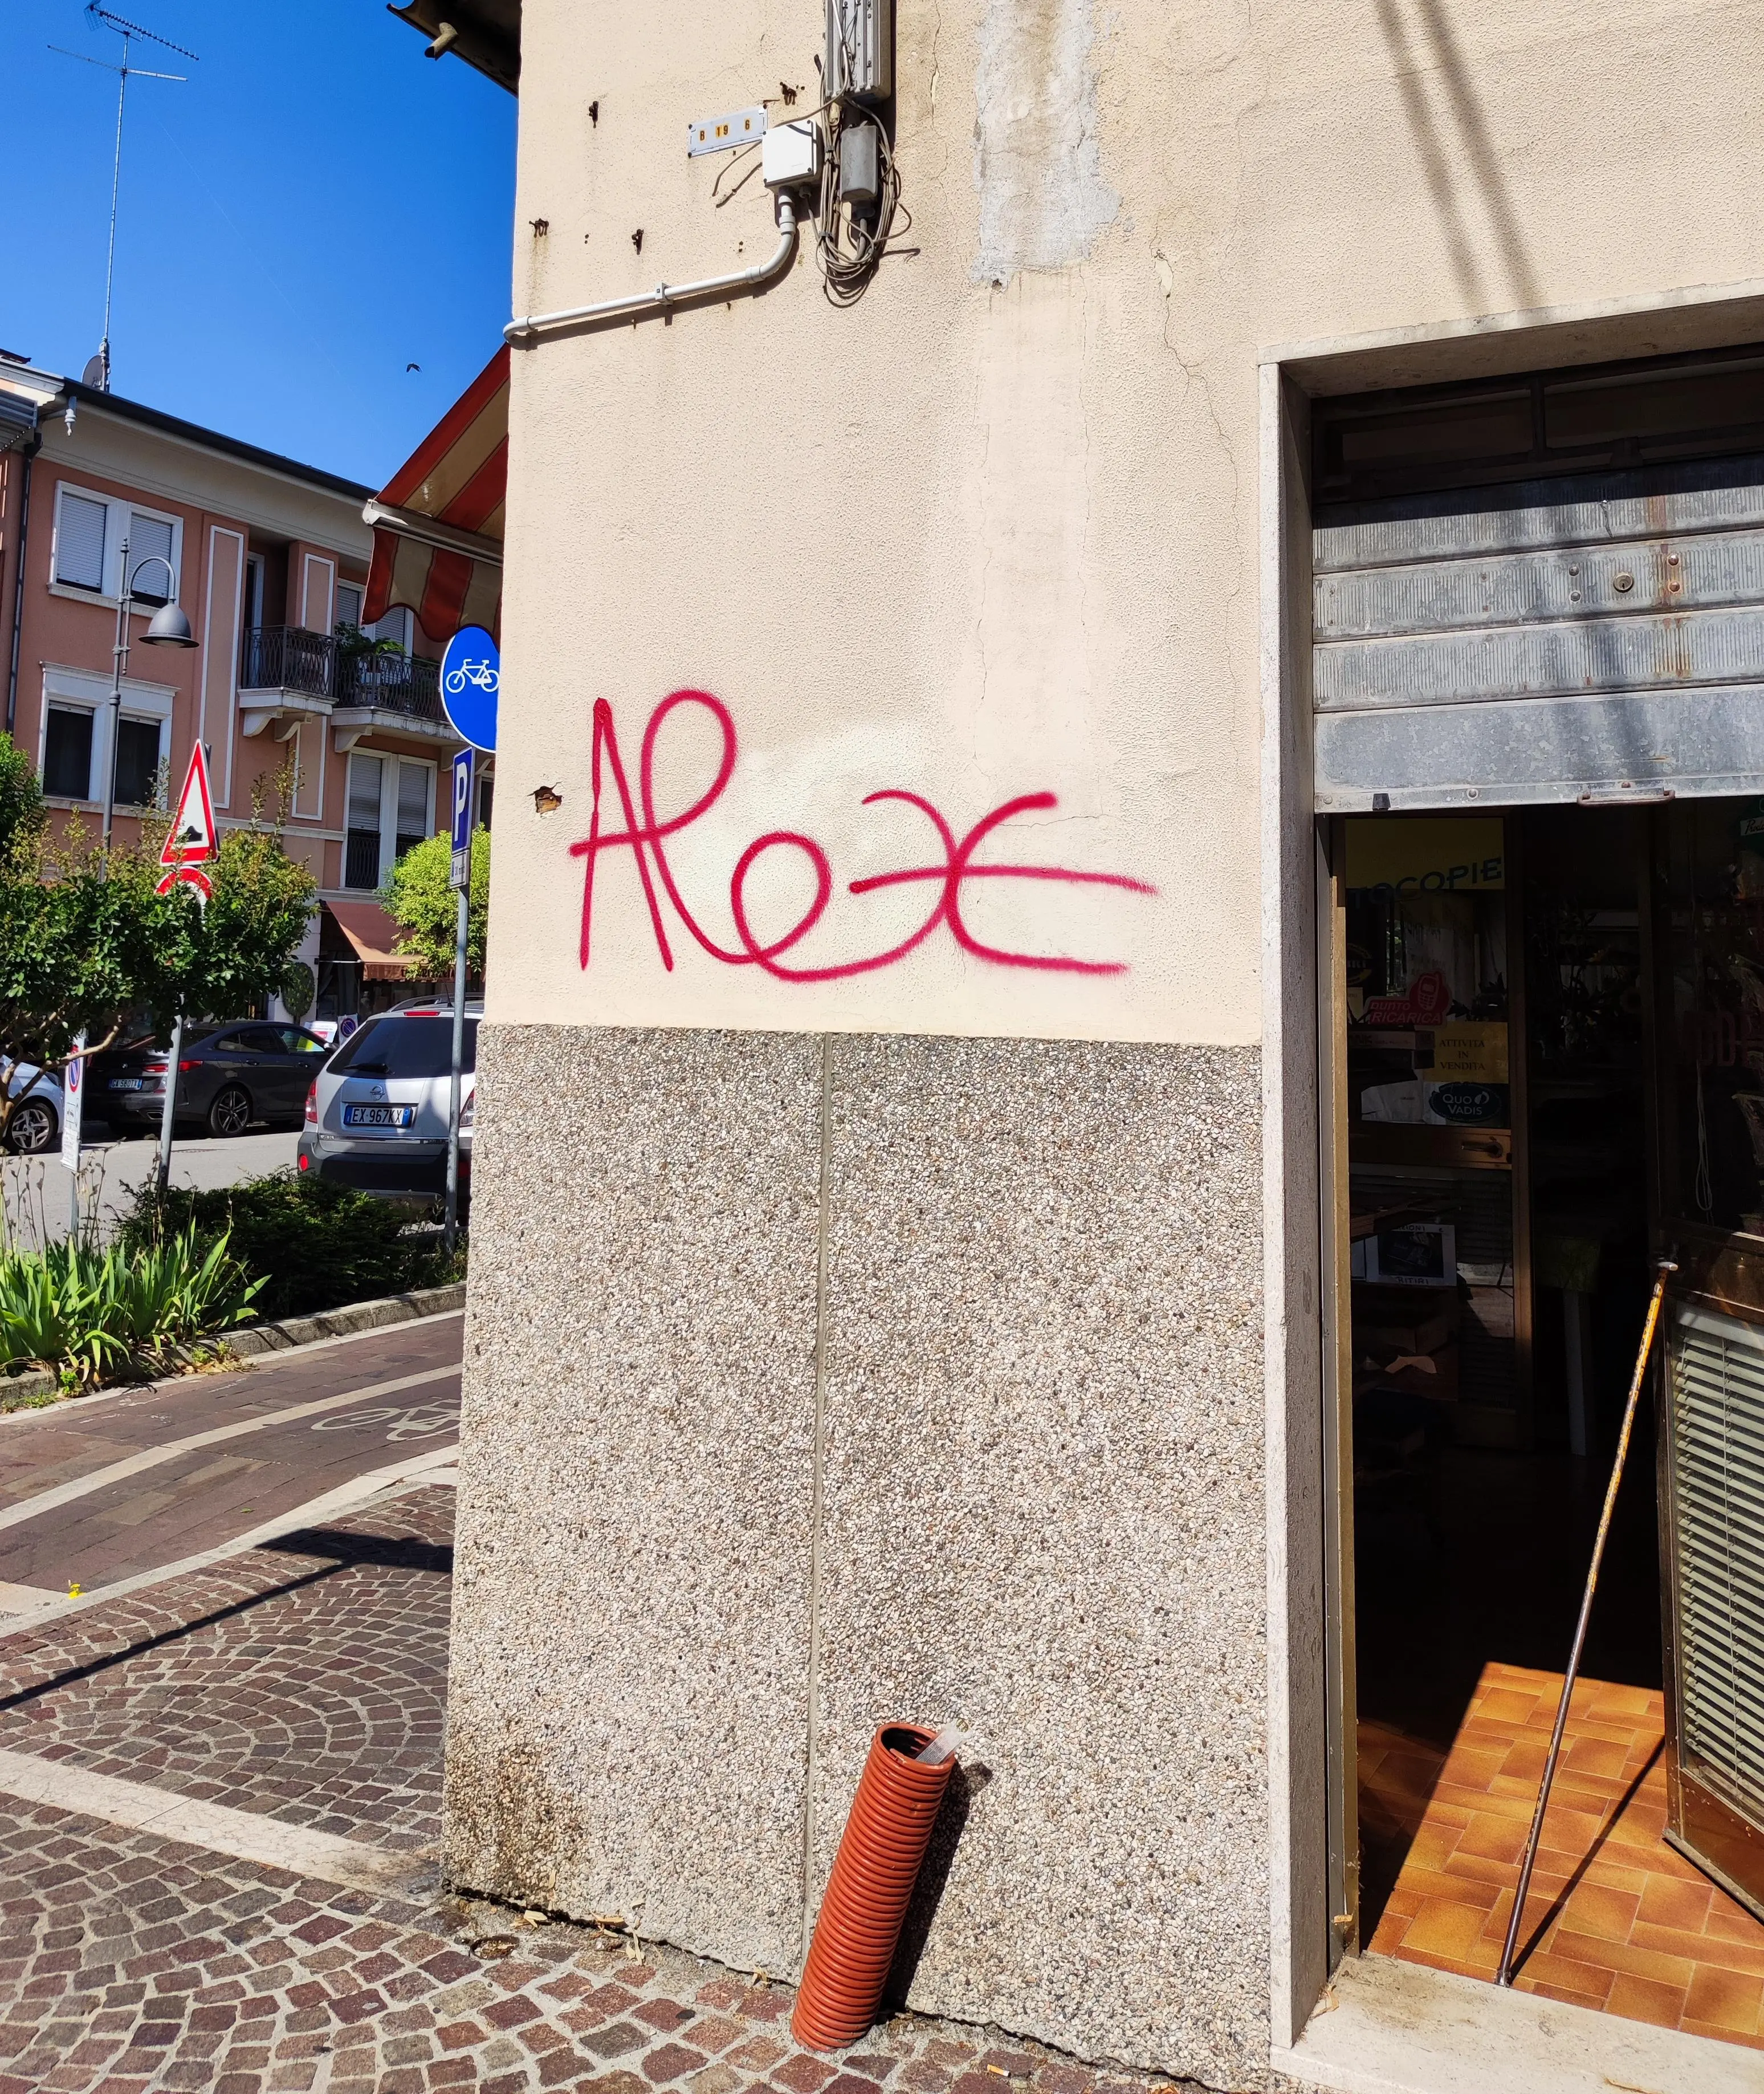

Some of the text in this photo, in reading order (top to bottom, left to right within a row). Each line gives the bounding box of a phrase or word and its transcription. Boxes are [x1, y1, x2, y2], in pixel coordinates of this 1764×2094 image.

[717, 125, 728, 137] 19
[745, 120, 749, 130] 6
[454, 762, 467, 842] P
[1372, 1011, 1441, 1023] RICARICA
[1458, 1050, 1469, 1059] IN
[1440, 1062, 1486, 1071] VENDITA
[1443, 1093, 1472, 1104] QUO
[1448, 1104, 1482, 1115] VADIS
